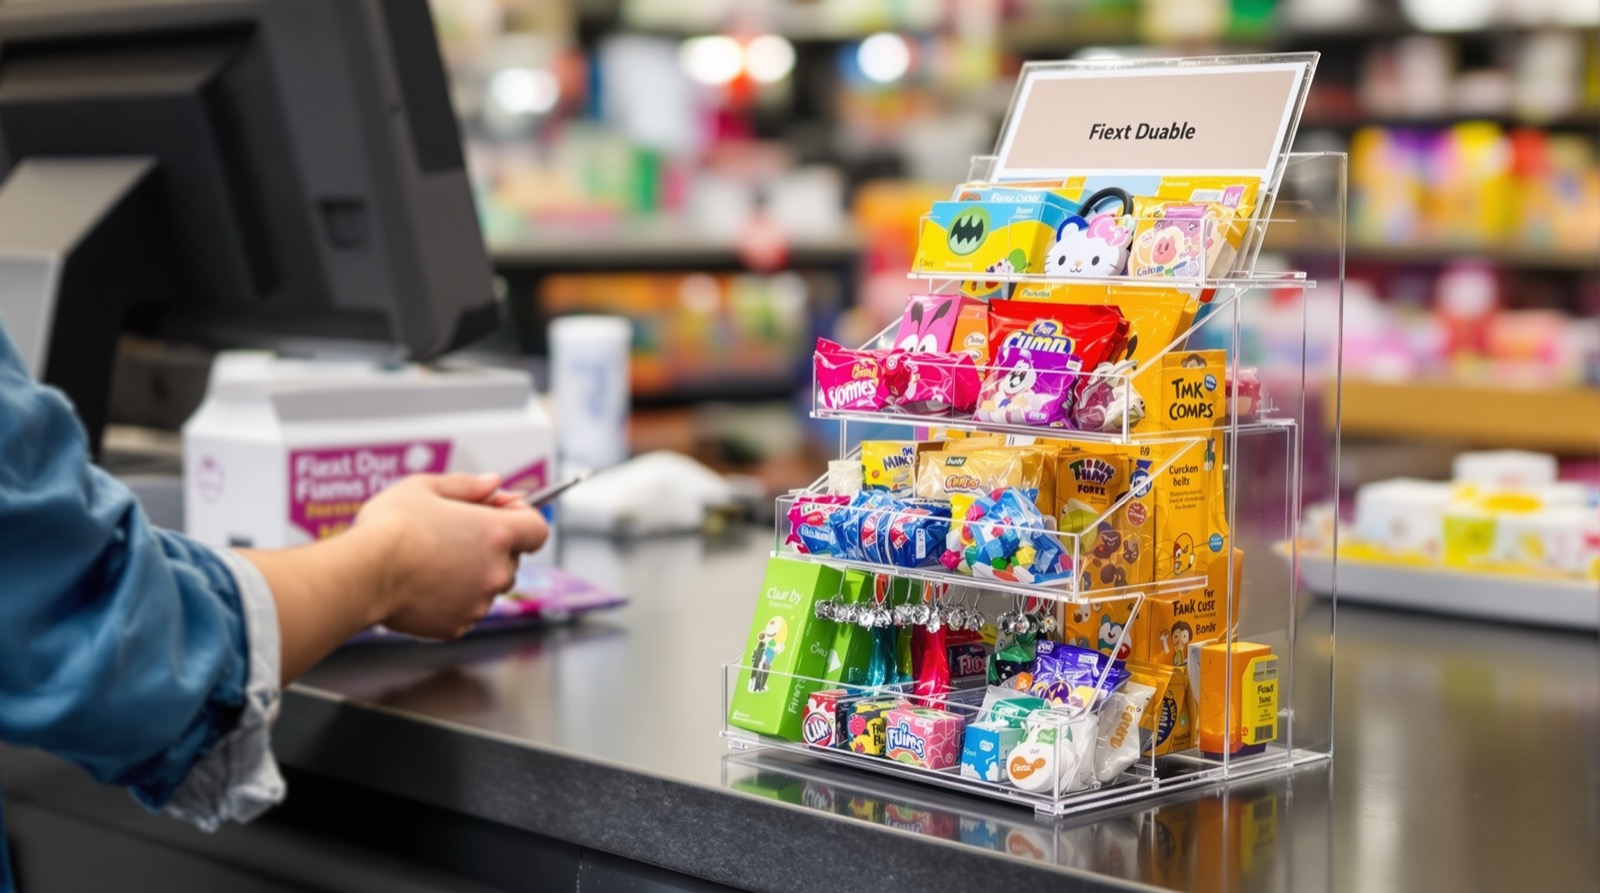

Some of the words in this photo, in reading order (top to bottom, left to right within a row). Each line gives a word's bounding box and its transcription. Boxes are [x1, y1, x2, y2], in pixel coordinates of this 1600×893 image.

[1089, 123, 1133, 140] Fiext
[1135, 121, 1196, 140] Duable
[1171, 378, 1204, 399] TMK
[1169, 402, 1214, 421] COMPS
